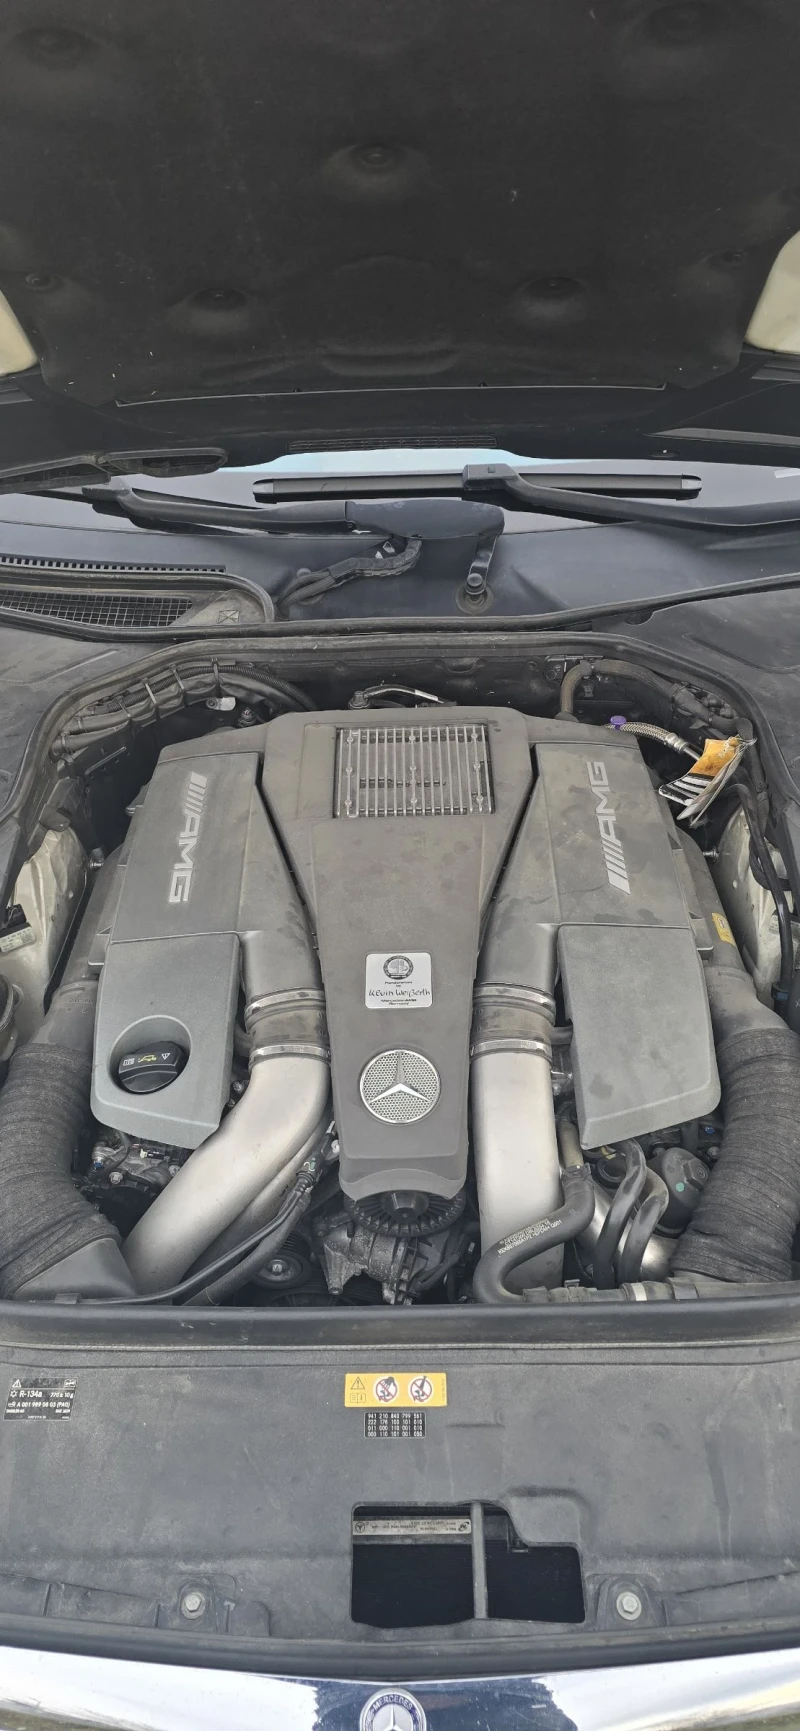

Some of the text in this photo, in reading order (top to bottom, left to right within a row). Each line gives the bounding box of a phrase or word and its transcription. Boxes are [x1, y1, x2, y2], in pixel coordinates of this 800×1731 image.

[587, 761, 623, 846] AMG
[168, 808, 202, 903] AMG
[19, 1390, 43, 1398] R-134a
[372, 1695, 413, 1710] MERCEDES
